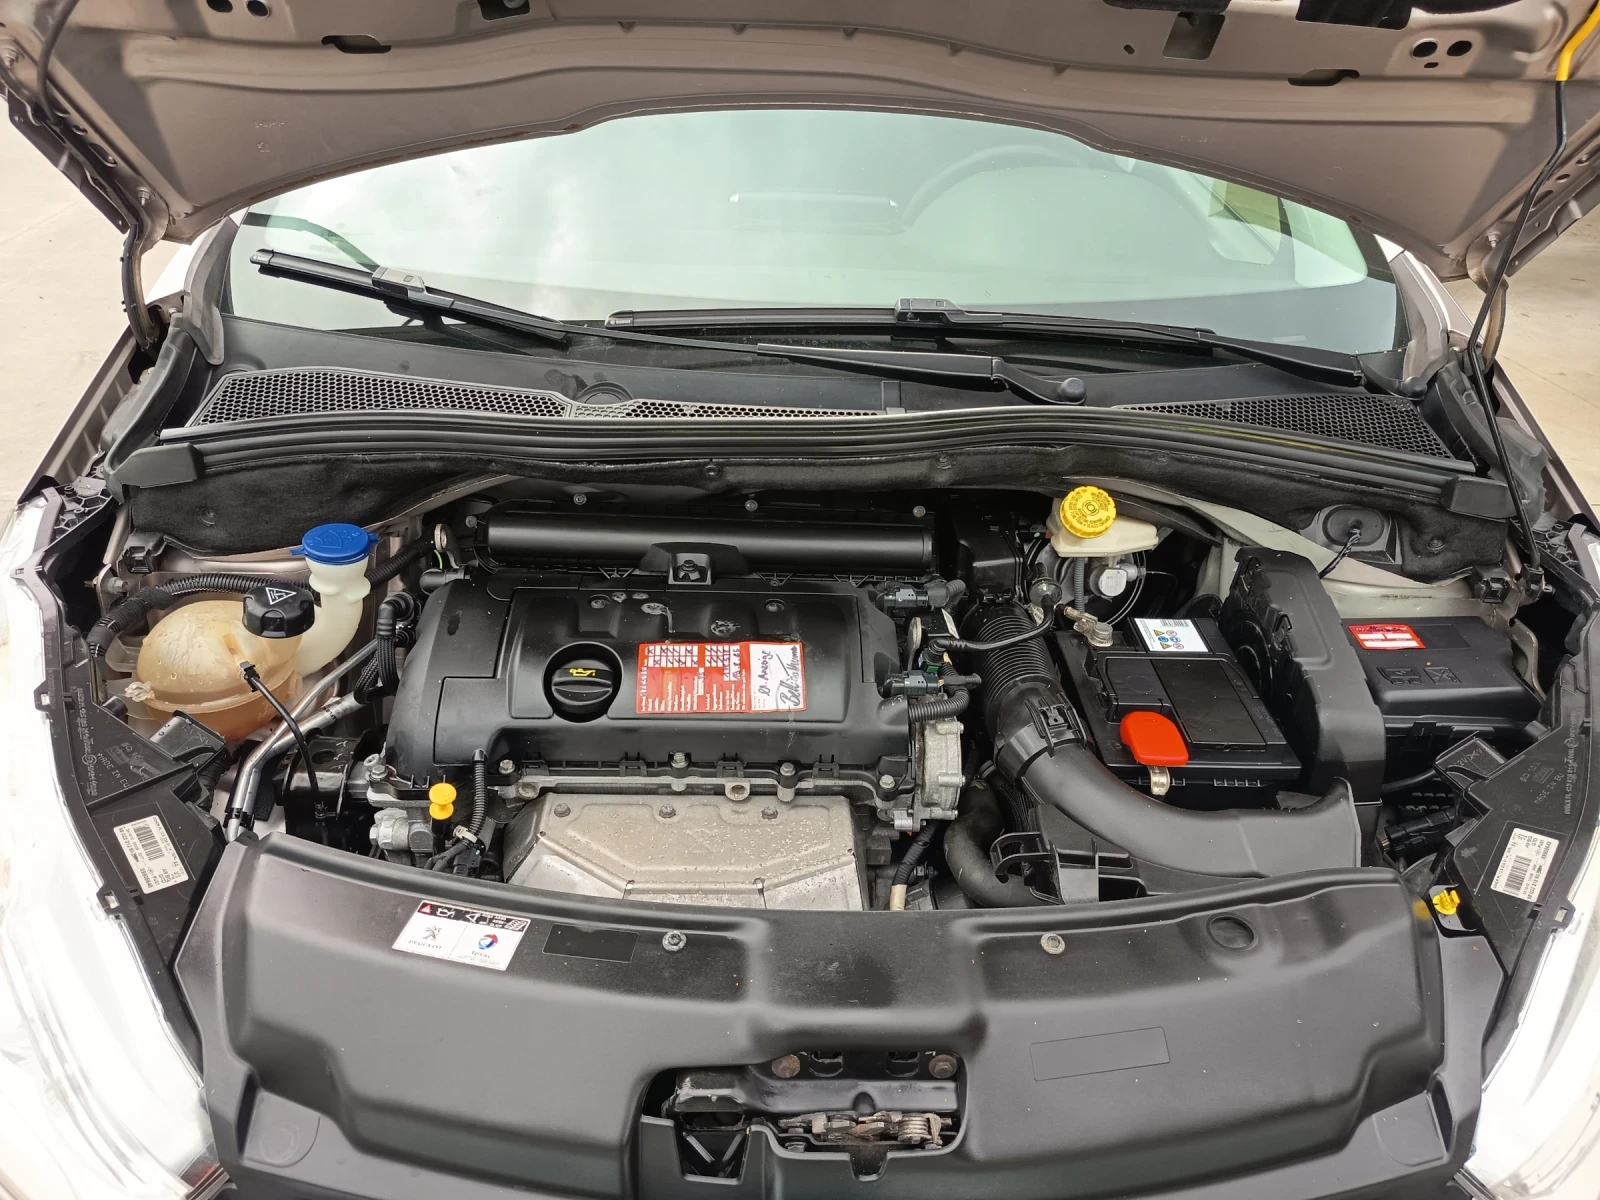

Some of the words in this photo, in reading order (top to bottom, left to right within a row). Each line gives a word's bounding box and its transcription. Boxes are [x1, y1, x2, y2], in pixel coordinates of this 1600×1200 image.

[96, 751, 115, 770] MADE
[110, 768, 123, 779] IN
[118, 777, 132, 789] EU
[1532, 787, 1550, 806] MADE
[1545, 779, 1557, 791] IN
[408, 939, 442, 950] PEUGEOT
